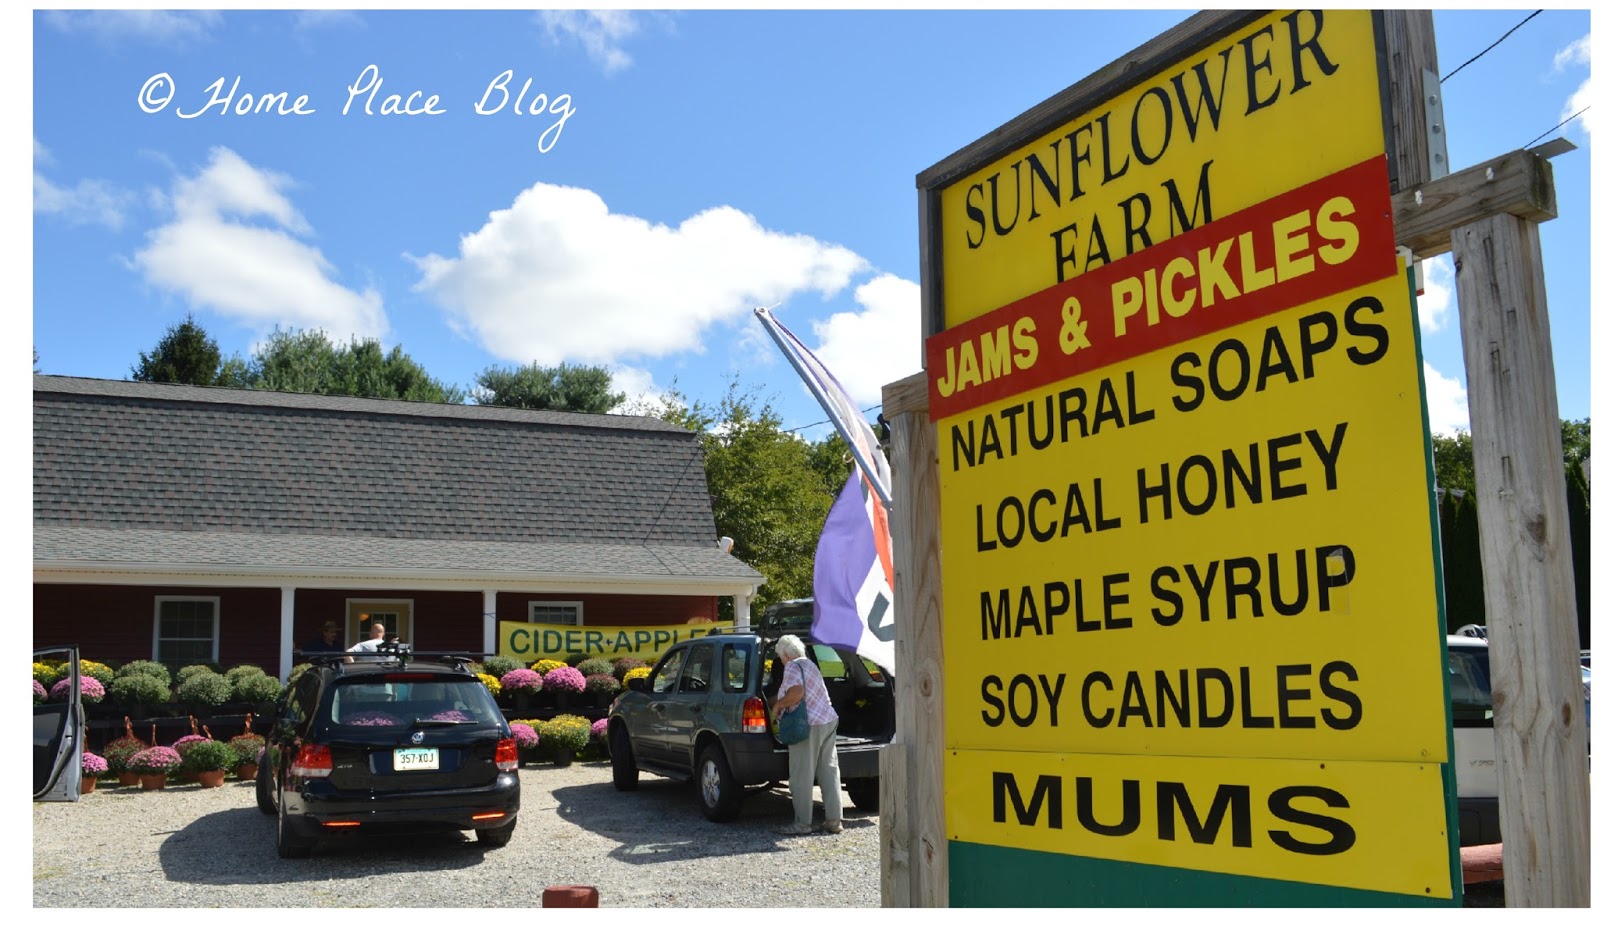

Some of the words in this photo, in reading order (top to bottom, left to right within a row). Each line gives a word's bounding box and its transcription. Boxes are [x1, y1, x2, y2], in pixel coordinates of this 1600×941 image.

[965, 10, 1340, 250] SUNFLOWER
[1050, 159, 1214, 285] FARM
[937, 317, 1039, 399] JAMS
[1059, 296, 1092, 355] &
[1111, 196, 1360, 338] PICKLES
[951, 370, 1156, 472] NATURAL
[1170, 296, 1390, 413] SOAPS
[976, 477, 1122, 553] LOCAL
[1136, 421, 1349, 525] HONEY
[980, 572, 1133, 641] MAPLE
[1150, 544, 1357, 627] SYRUP
[981, 673, 1067, 728] SOY
[1081, 660, 1363, 731] CANDLES
[991, 771, 1357, 856] MUMS
